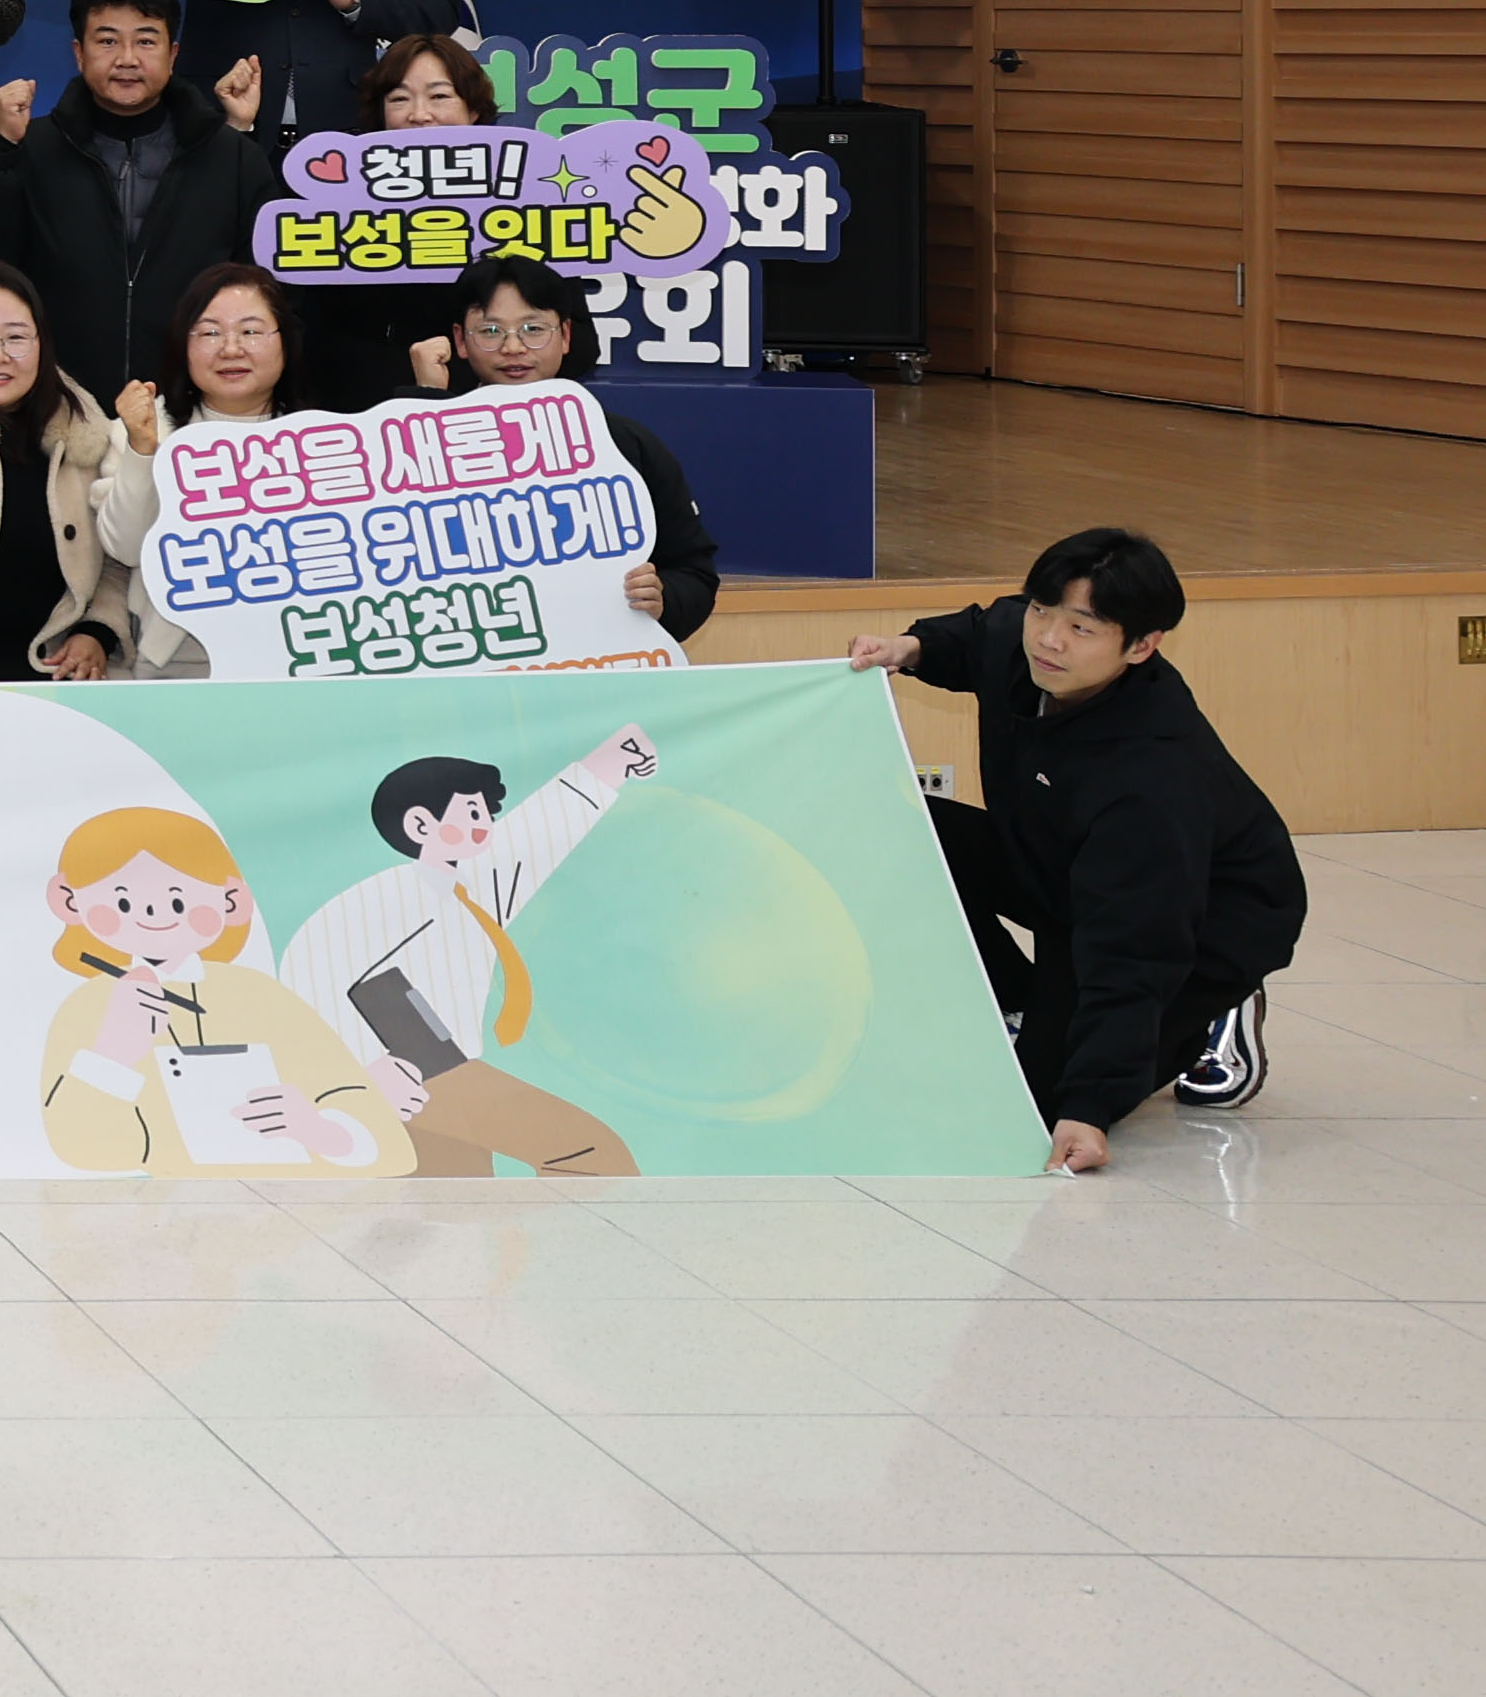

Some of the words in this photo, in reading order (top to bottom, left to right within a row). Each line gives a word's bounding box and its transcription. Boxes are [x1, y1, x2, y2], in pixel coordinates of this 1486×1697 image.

[362, 141, 528, 200] 청년!
[274, 209, 473, 271] 보성을
[481, 202, 618, 266] 잇다
[172, 422, 375, 522] 보성을
[380, 394, 596, 495] 새롭게!
[159, 511, 363, 612] 보성을
[362, 474, 647, 586] 위대하게!
[280, 575, 549, 677] 보성청년
